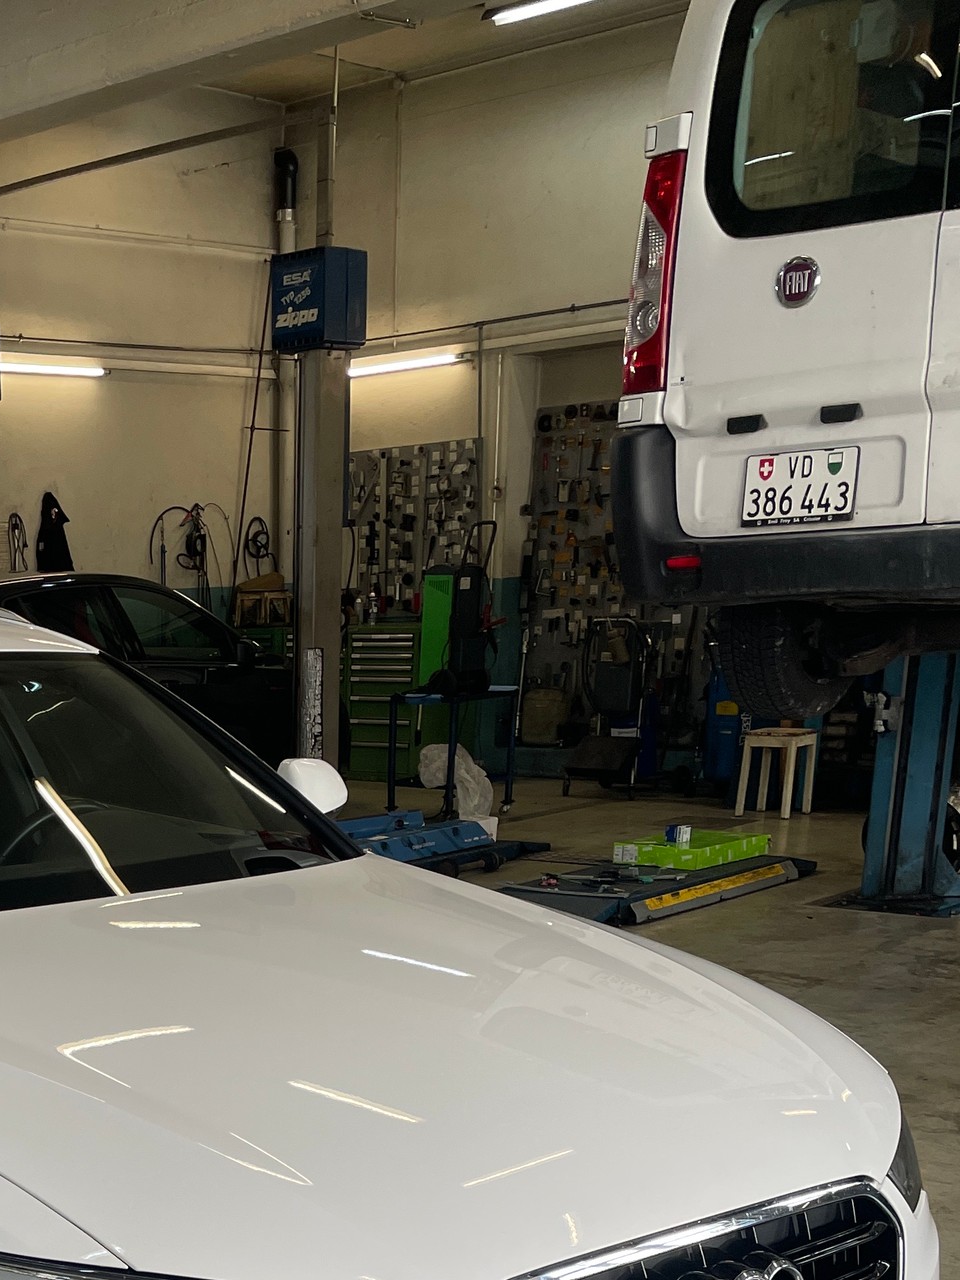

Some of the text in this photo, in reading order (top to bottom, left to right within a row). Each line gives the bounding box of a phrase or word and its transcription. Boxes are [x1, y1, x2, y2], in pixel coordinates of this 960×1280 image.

[282, 271, 311, 286] ESA
[785, 269, 811, 295] FIAT
[275, 306, 319, 328] zippo
[788, 455, 813, 479] VD
[746, 481, 850, 518] 386 443
